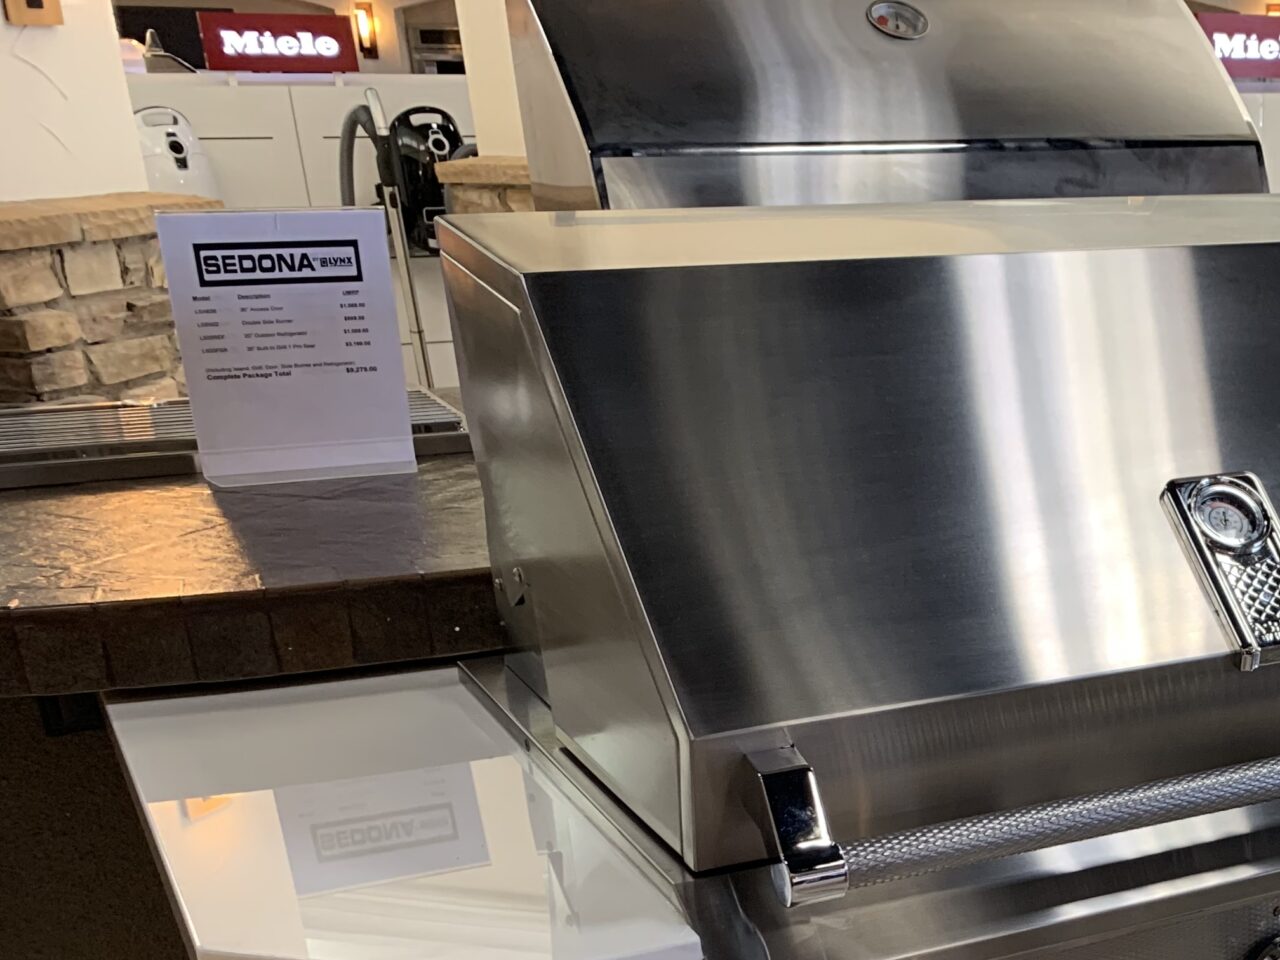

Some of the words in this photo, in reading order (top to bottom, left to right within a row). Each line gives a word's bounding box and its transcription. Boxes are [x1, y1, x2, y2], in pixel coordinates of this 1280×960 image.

[219, 30, 340, 56] Miele
[203, 253, 316, 274] SEDONA
[329, 256, 353, 267] LYNX
